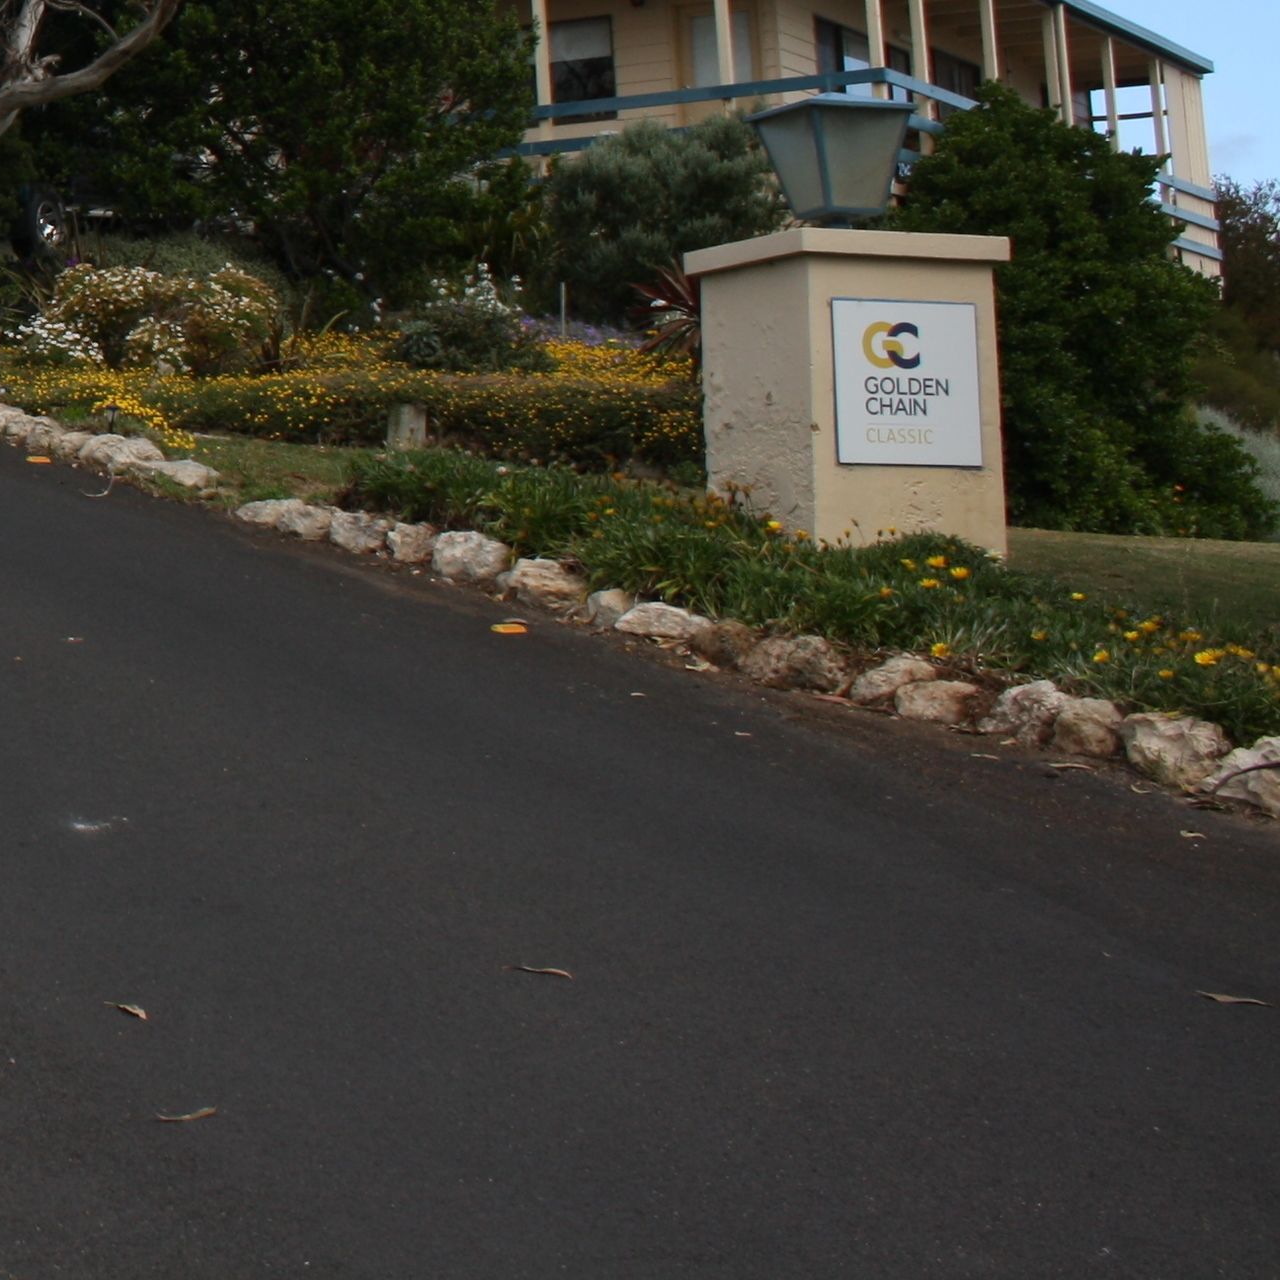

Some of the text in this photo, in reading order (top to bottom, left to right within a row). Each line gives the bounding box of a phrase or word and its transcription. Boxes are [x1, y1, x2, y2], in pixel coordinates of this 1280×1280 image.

[864, 376, 949, 396] GOLDEN
[865, 397, 927, 416] CHAIN
[866, 427, 934, 445] CLASSIC
